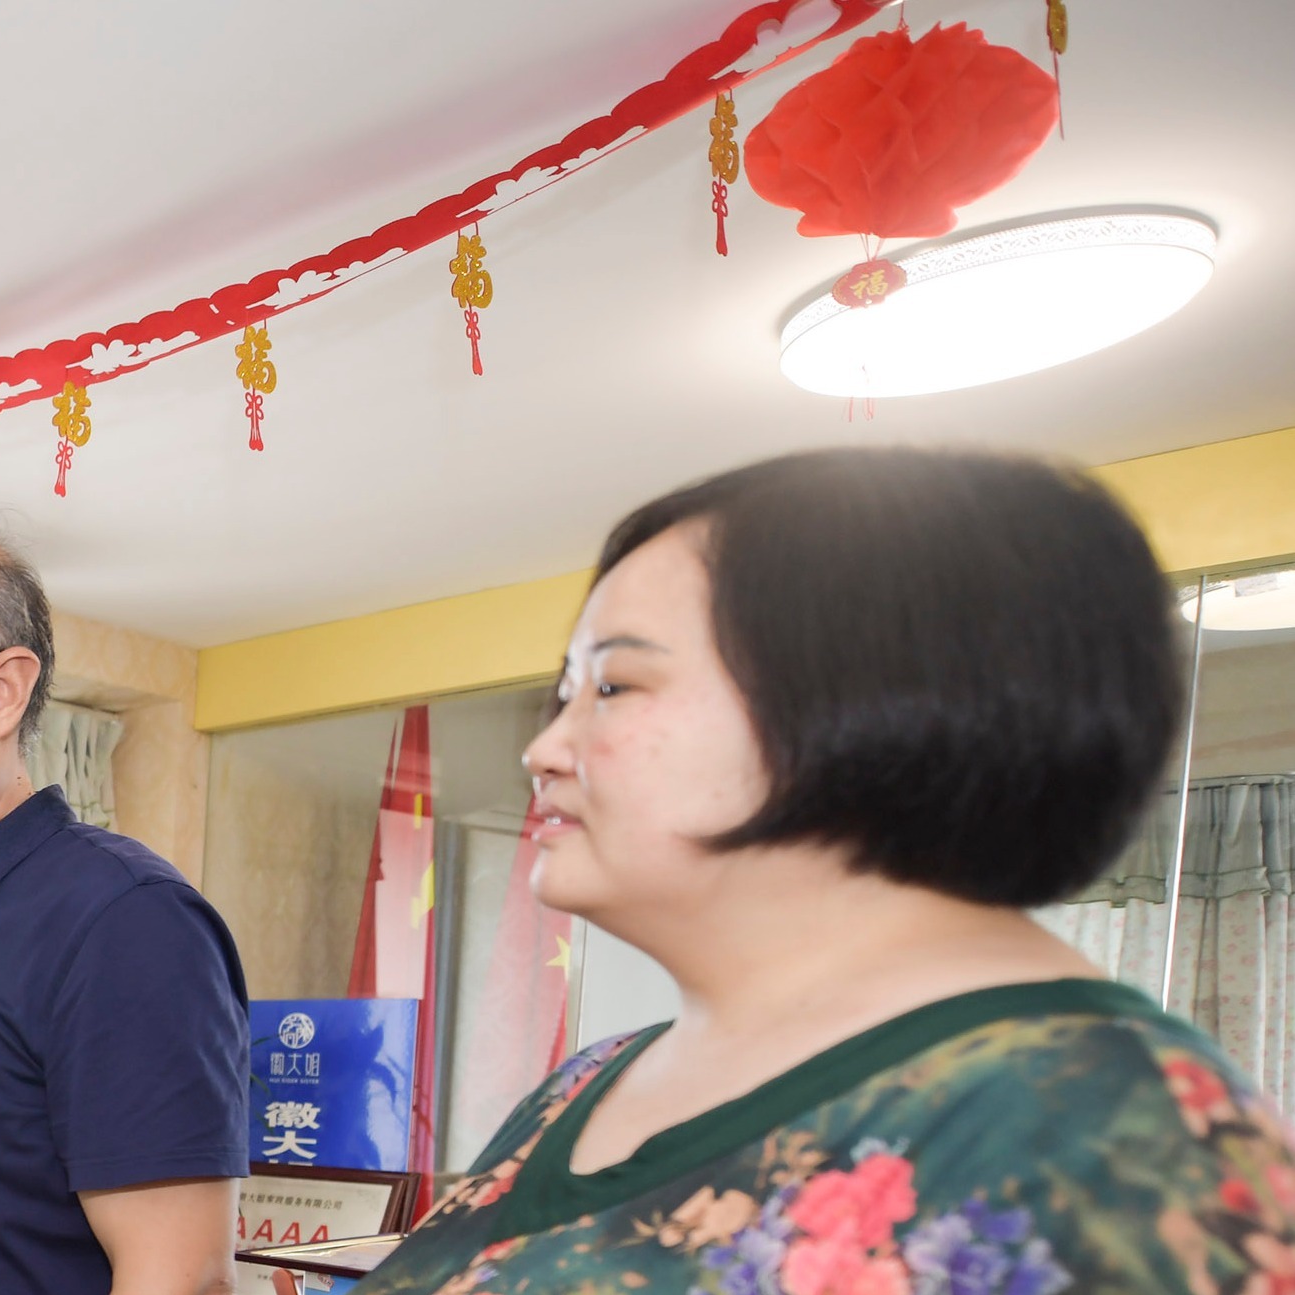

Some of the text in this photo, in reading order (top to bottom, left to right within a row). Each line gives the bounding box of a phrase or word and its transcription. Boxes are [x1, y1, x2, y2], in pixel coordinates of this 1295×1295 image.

[449, 235, 493, 309] 福
[849, 269, 889, 300] 福
[235, 325, 277, 394] 福
[52, 380, 92, 447] 福
[270, 1052, 320, 1077] 徽大姐
[262, 1101, 321, 1167] 徽大
